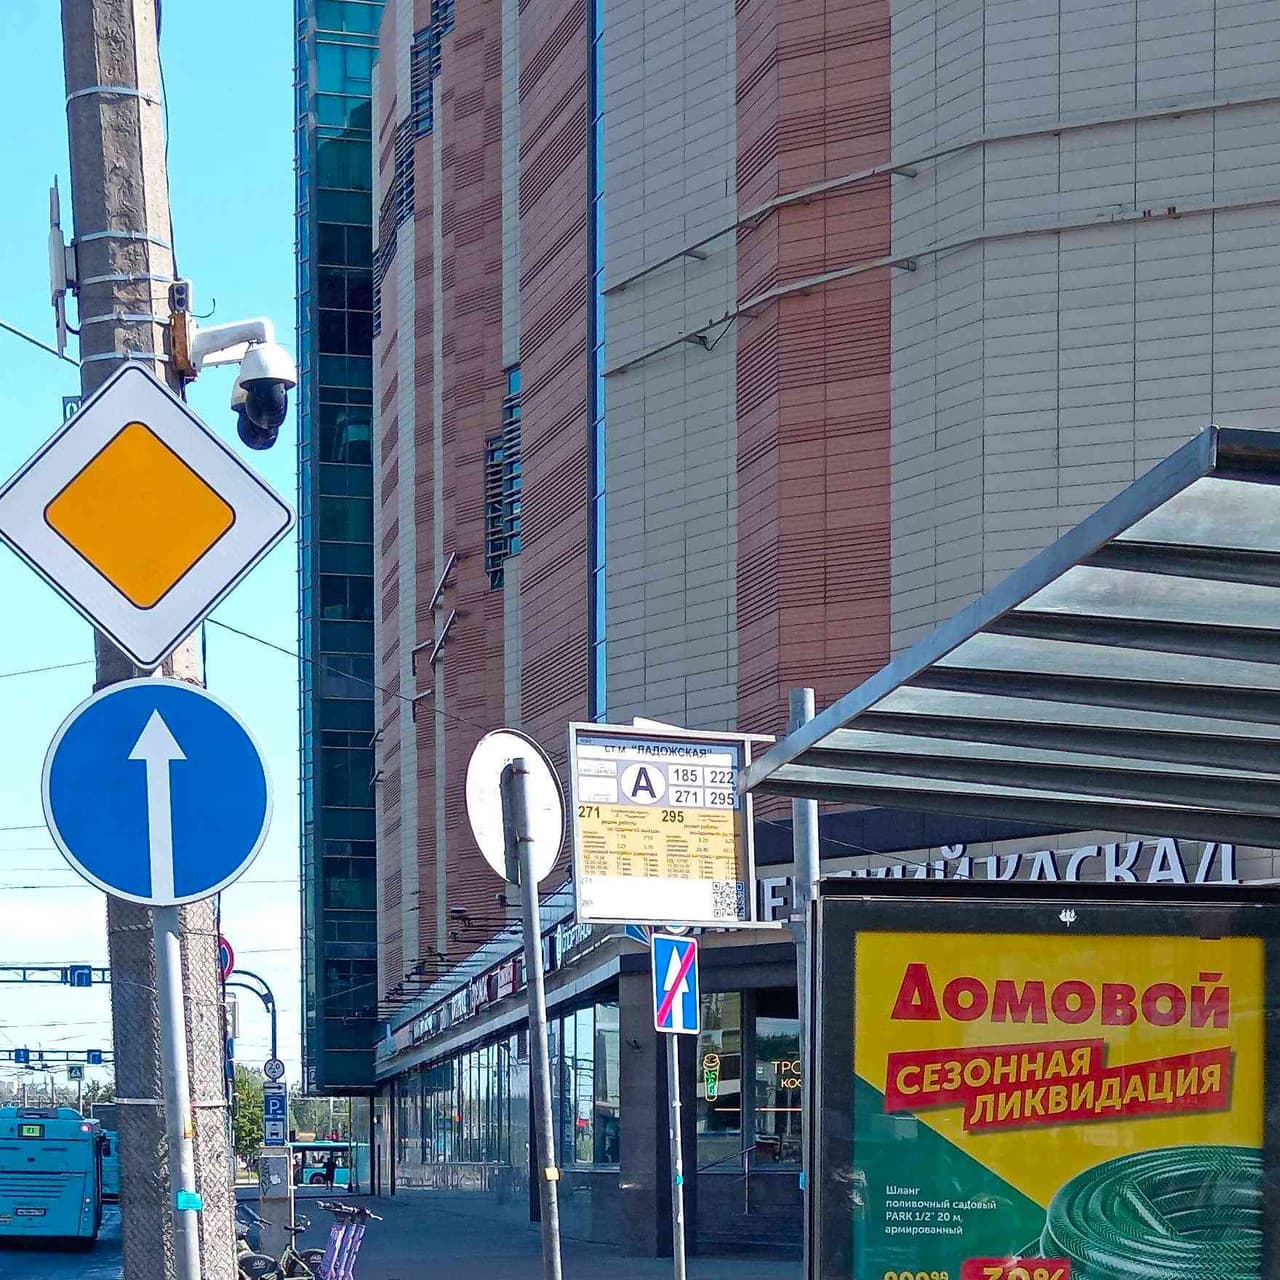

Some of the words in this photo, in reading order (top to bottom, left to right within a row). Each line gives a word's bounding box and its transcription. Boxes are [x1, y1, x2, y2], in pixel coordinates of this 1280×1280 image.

[673, 768, 698, 783] 185
[709, 770, 734, 785] 222
[674, 790, 699, 804] 271
[710, 792, 735, 806] 295
[578, 805, 600, 819] 271
[661, 809, 685, 823] 295
[895, 1046, 1092, 1095] СЕЗОННАЯ
[968, 1063, 1222, 1125] ЛИКВИДАЦИЯ
[885, 1185, 921, 1196] Шланг
[885, 1200, 950, 1210] поливочный
[952, 1200, 997, 1211] садовый
[885, 1212, 913, 1222] PARK
[937, 1212, 951, 1222] 20
[885, 1226, 964, 1236] армированный
